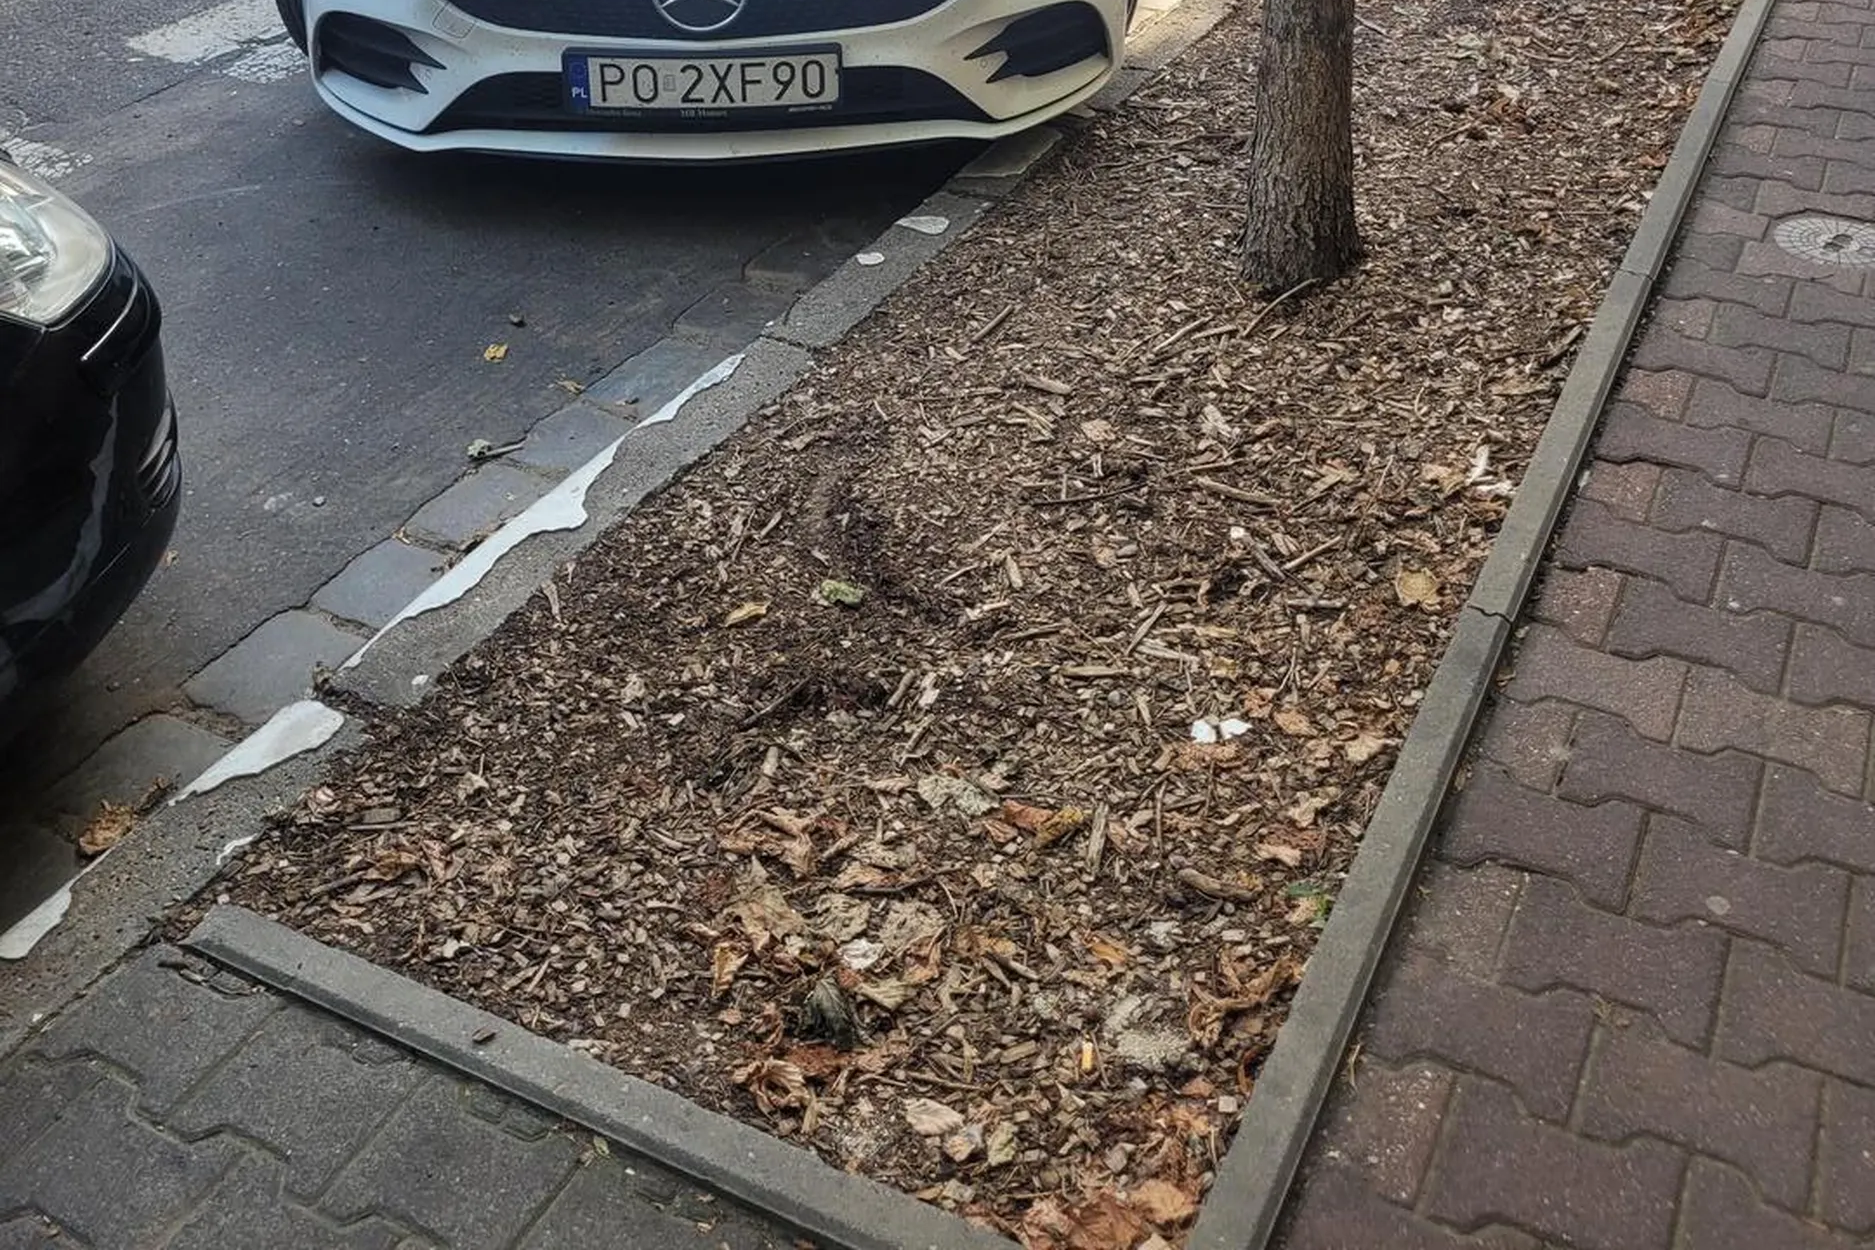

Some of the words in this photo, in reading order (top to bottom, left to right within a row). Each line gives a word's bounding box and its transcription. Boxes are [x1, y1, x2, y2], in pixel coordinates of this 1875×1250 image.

[571, 86, 588, 98] PL
[599, 63, 659, 103] PO
[680, 59, 826, 104] 2XF90
